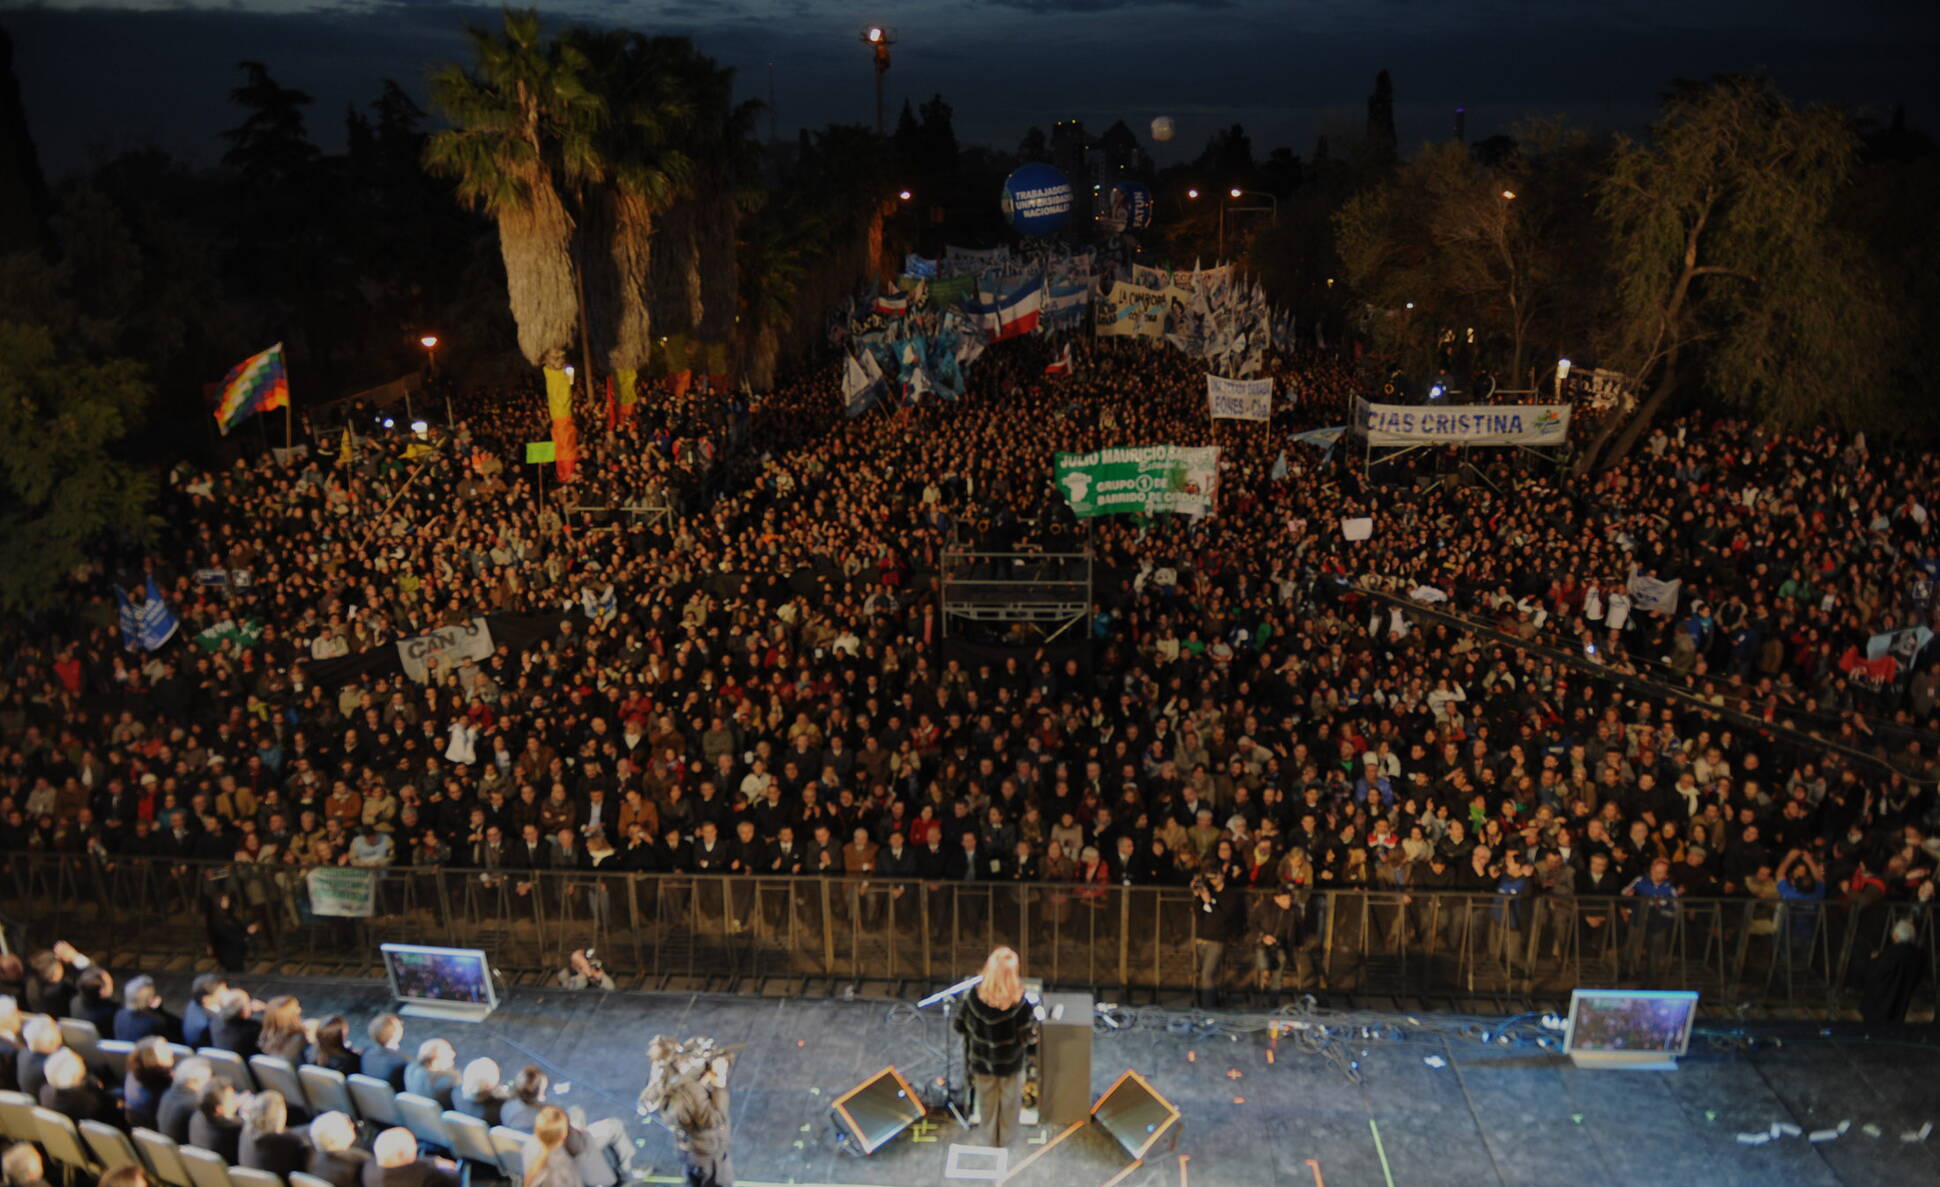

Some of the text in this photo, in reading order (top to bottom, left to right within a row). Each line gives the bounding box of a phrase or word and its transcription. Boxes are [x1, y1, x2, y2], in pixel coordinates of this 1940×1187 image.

[1421, 414, 1523, 434] CRISTINA
[1060, 453, 1099, 468] JULIO
[1101, 447, 1166, 465] MAURICIO
[1096, 479, 1135, 492] GRUPO
